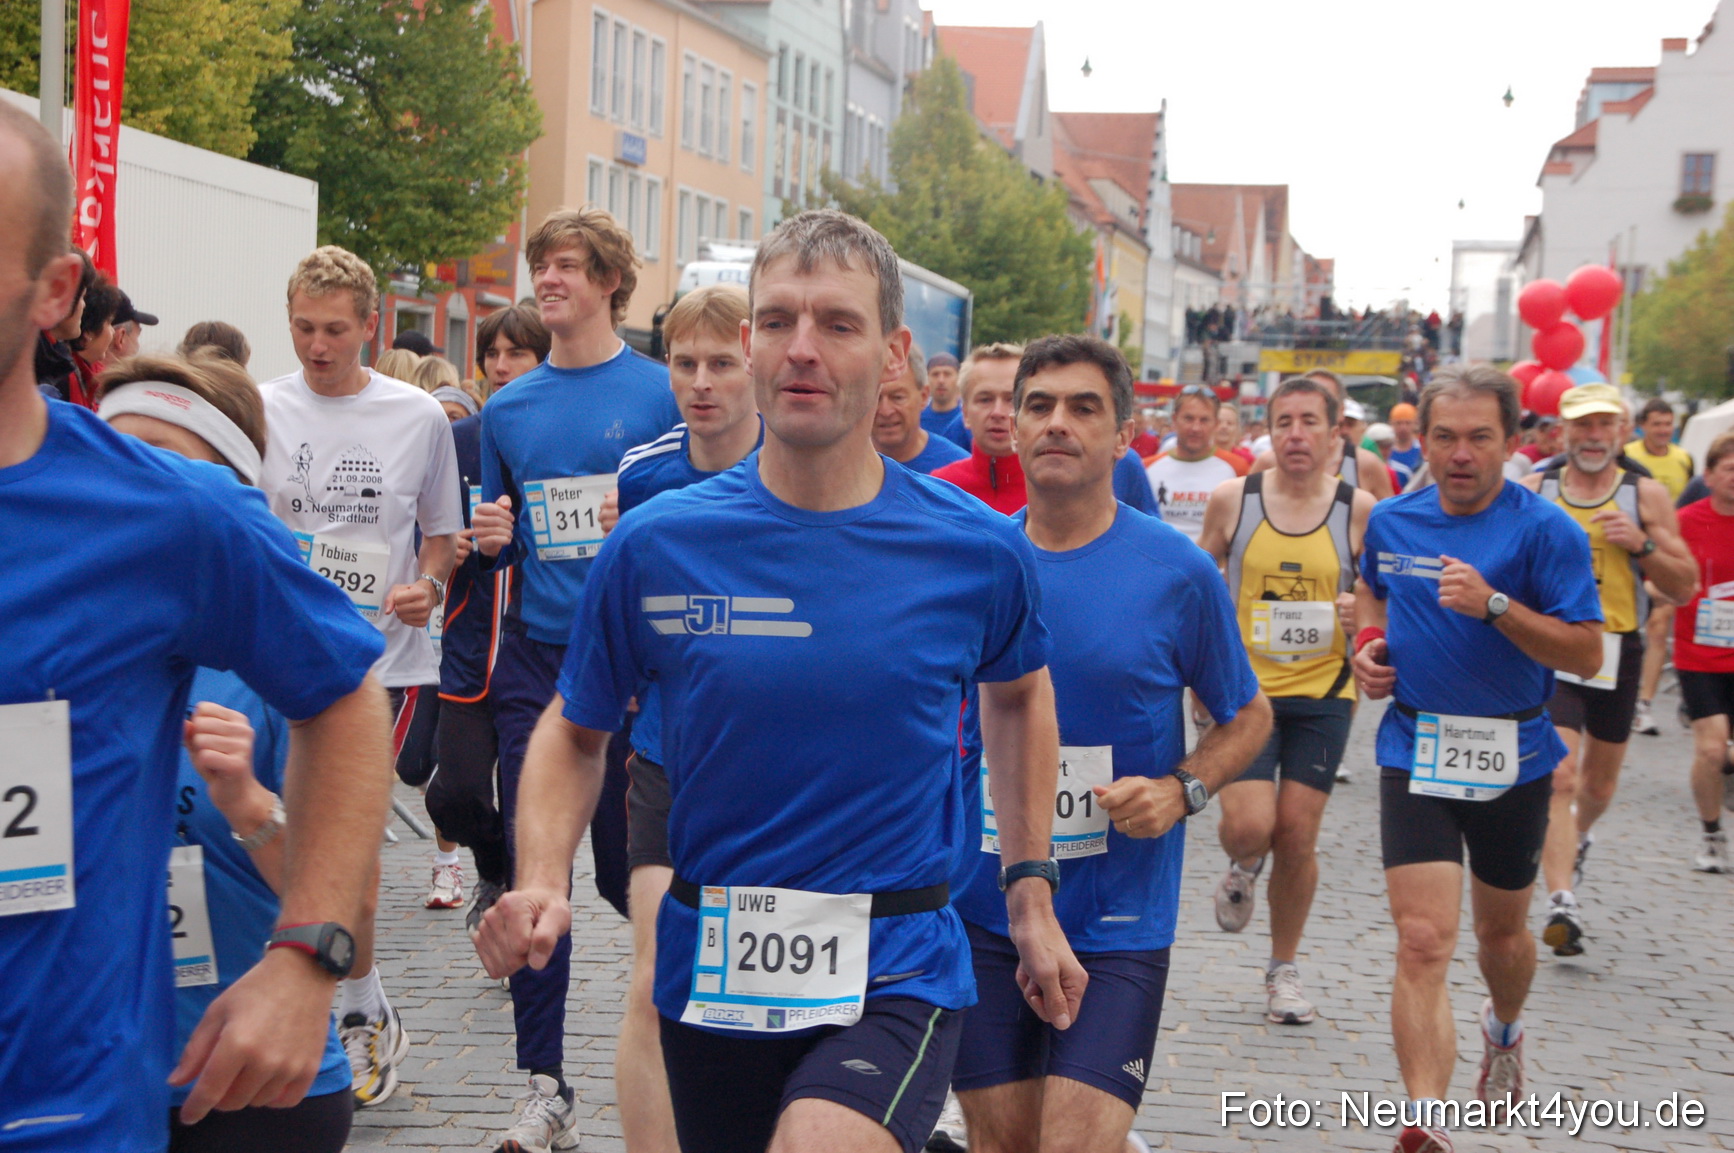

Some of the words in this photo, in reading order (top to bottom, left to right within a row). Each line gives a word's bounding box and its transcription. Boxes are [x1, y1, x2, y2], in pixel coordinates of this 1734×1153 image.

[332, 474, 383, 484] 21.09.2008
[550, 487, 583, 502] Peter
[312, 503, 380, 514] Neumarkter
[328, 513, 379, 525] Stadtlauf
[320, 543, 358, 563] Tobias
[1273, 607, 1304, 620] Franz
[1281, 627, 1319, 645] 438
[1444, 724, 1497, 742] Hartmut
[1445, 747, 1505, 772] 2150
[1056, 837, 1105, 852] PFLEIDERER
[707, 927, 716, 948] B
[738, 931, 839, 975] 2091
[788, 1004, 859, 1022] PFLEIDERER
